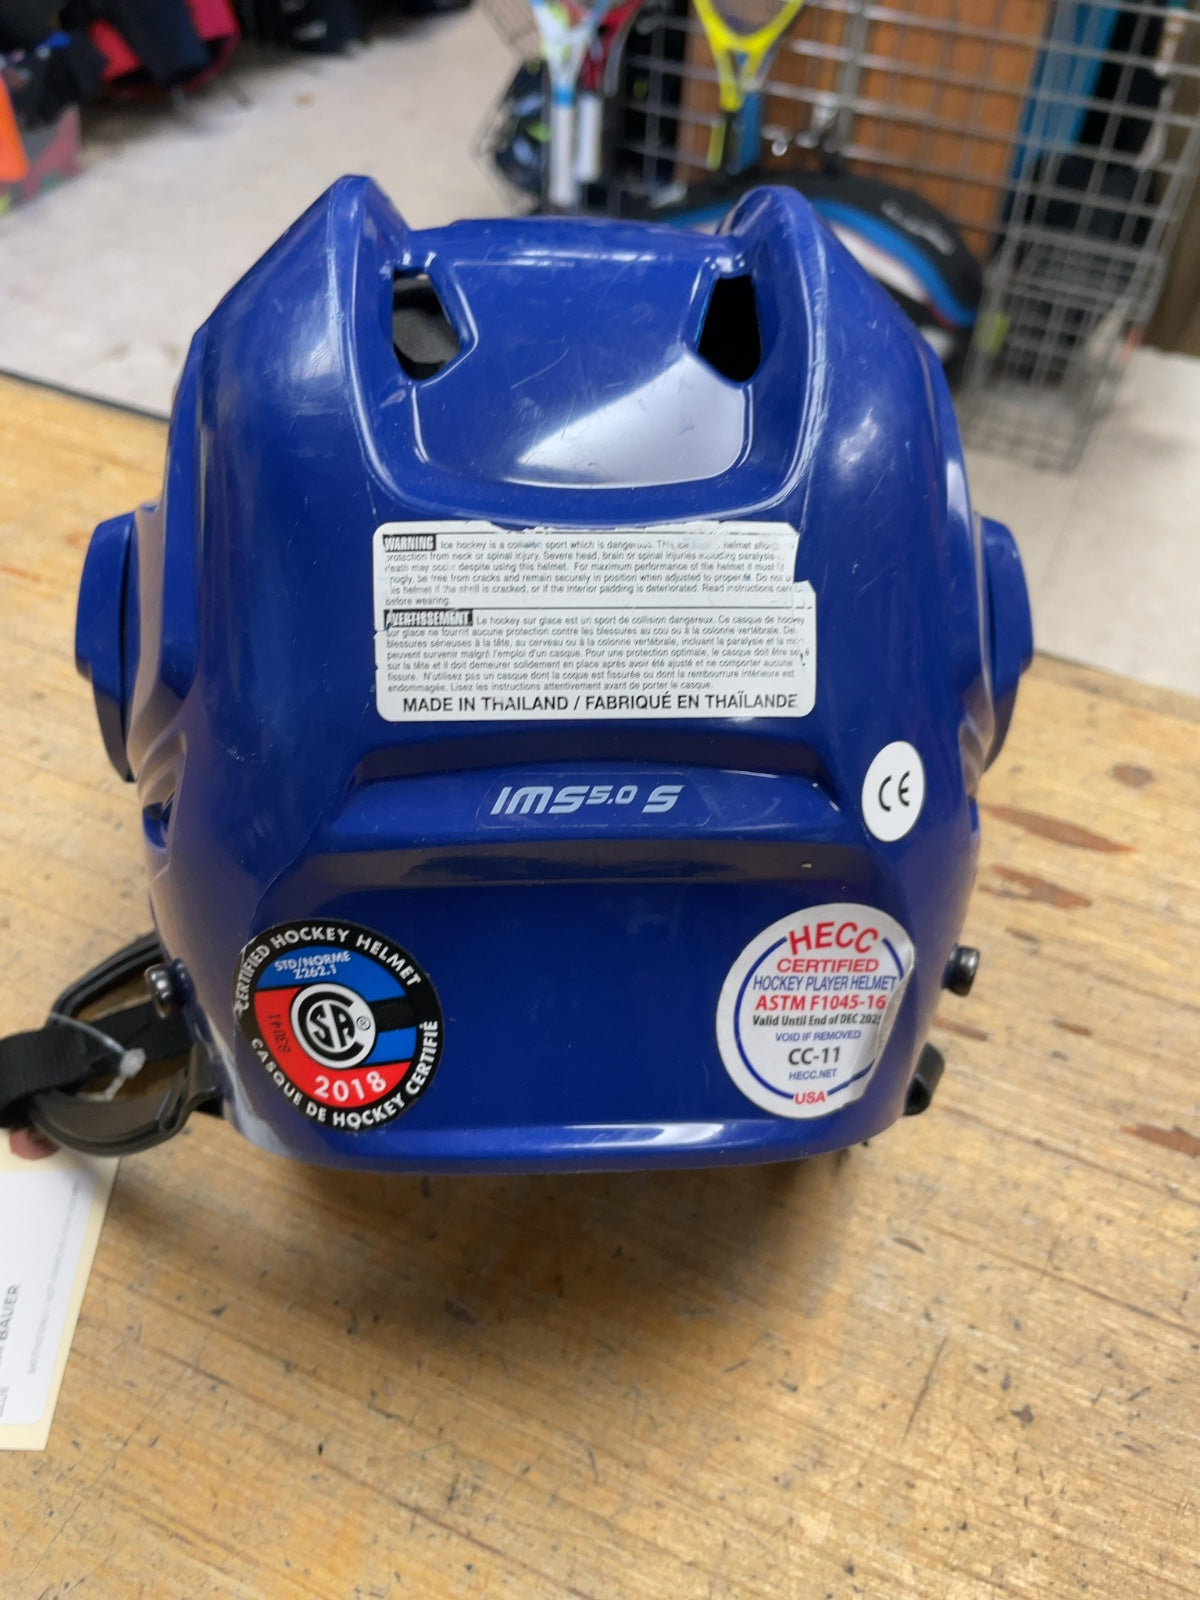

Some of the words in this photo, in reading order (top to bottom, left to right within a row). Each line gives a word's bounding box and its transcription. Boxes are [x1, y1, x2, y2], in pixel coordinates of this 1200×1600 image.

[384, 535, 435, 551] WARNING
[385, 611, 470, 627] AVERTISSEMENT
[402, 697, 453, 712] MADE
[459, 697, 476, 712] IN
[481, 696, 569, 712] THAILAND
[573, 696, 580, 711] /
[586, 690, 672, 710] FABRIQUÉ
[677, 694, 700, 710] EN
[704, 690, 798, 710] THAÏLANDE
[641, 784, 684, 814] S
[788, 922, 878, 956] HECC
[236, 944, 270, 1012] CERTIFIED
[270, 926, 350, 950] HOCKEY
[355, 934, 422, 986] HELMET
[274, 951, 352, 972] STD/NORME
[776, 958, 879, 974] CERTIFIED
[294, 964, 337, 980] Z262.1
[752, 975, 802, 992] HOCKEY
[805, 975, 848, 992] PLAYER
[850, 975, 898, 991] HELMET
[755, 995, 806, 1011] ASTM
[810, 994, 886, 1011] F1045-16
[752, 1014, 778, 1026] Valid
[781, 1014, 806, 1026] Until
[808, 1014, 826, 1025] End
[828, 1014, 838, 1025] of
[840, 1013, 858, 1024] DEC
[776, 1031, 800, 1042] VOID
[802, 1031, 812, 1042] IF
[814, 1030, 862, 1041] REMOVED
[788, 1046, 842, 1066] CC-11
[251, 1038, 302, 1106] CASQUE
[306, 1103, 326, 1122] DE
[332, 1094, 406, 1130] HOCKEY
[405, 1020, 438, 1094] CERTIFIÉ
[788, 1068, 838, 1080] HECC.NET
[314, 1071, 387, 1102] 2018
[794, 1090, 826, 1105] USA
[0, 1283, 20, 1341] BAUER
